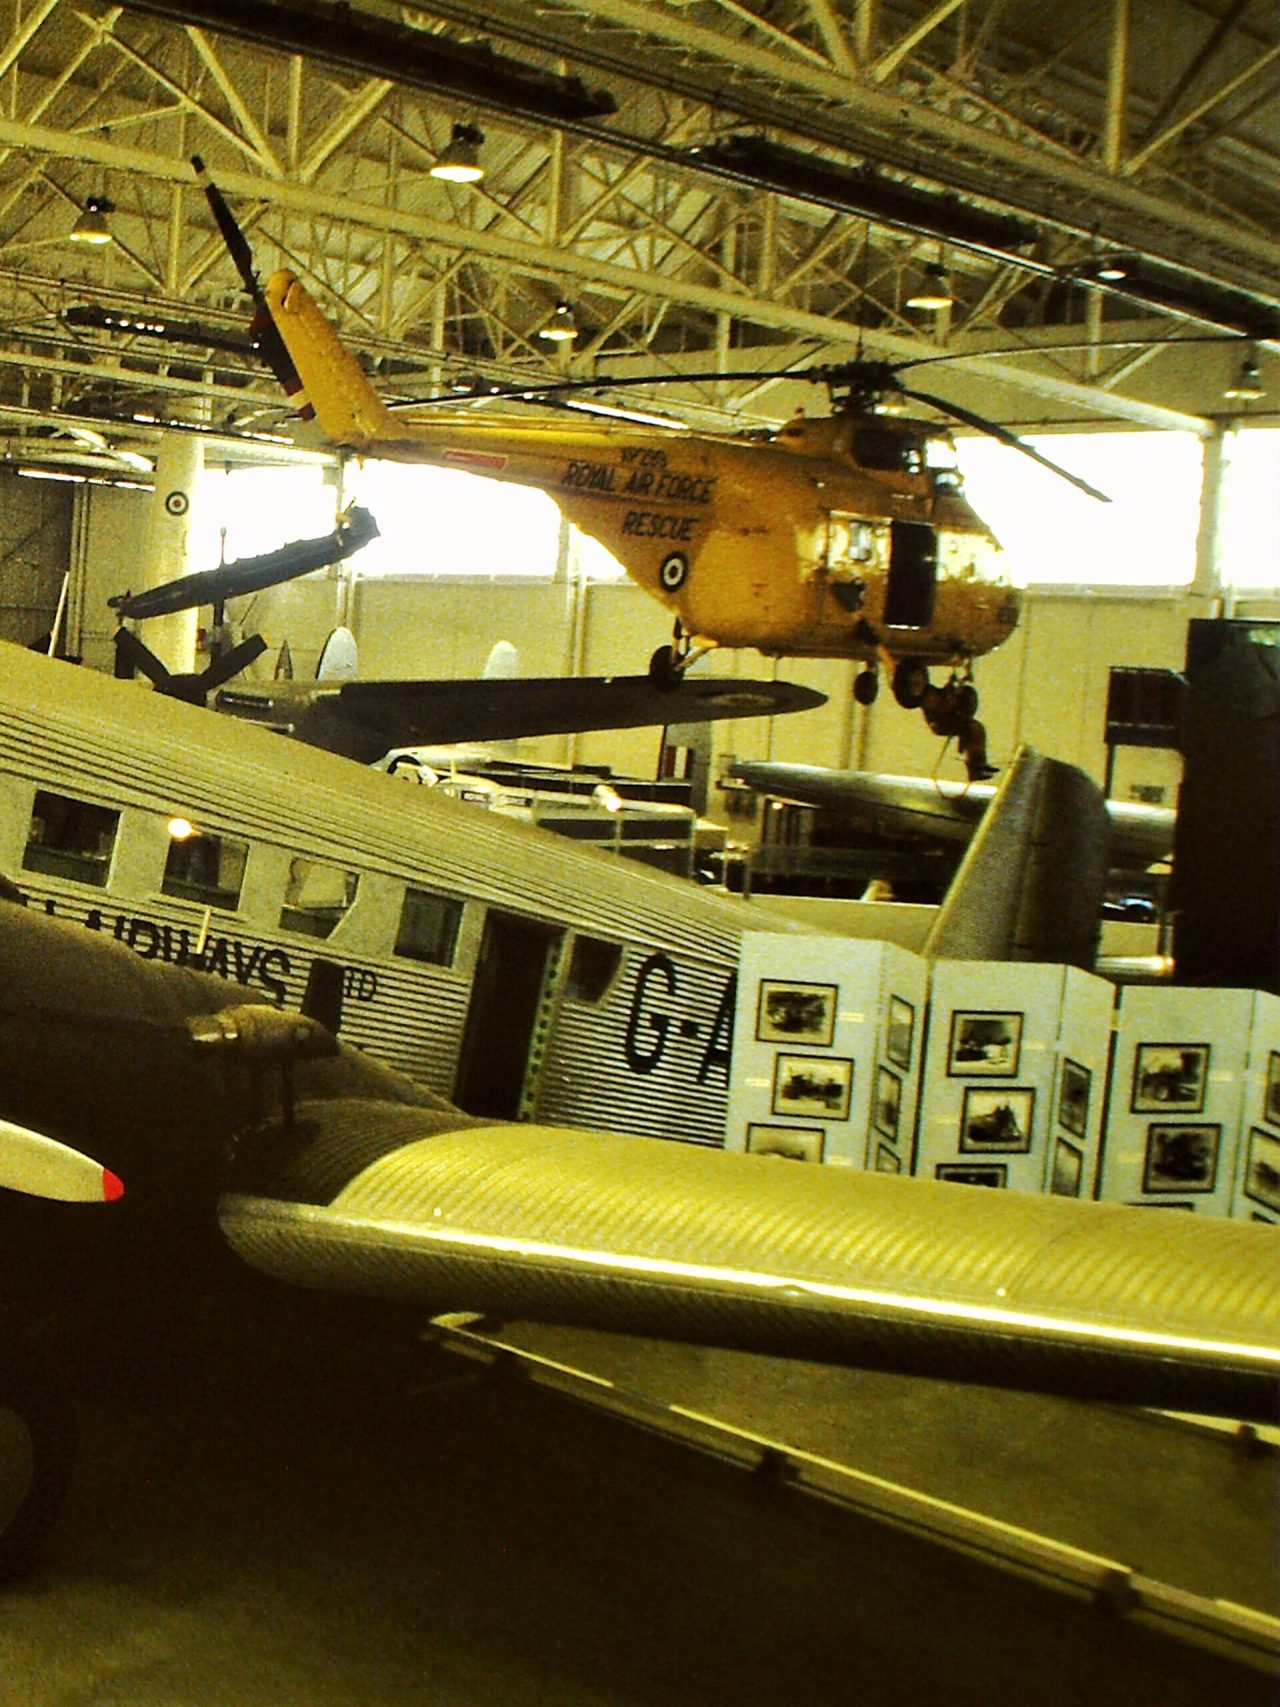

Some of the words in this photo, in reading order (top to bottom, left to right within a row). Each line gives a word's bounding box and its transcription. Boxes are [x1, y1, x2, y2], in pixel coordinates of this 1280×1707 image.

[562, 461, 616, 492] ROYAL
[623, 469, 654, 496] AIR
[654, 473, 718, 503] FORCE
[622, 511, 699, 541] RESCUE
